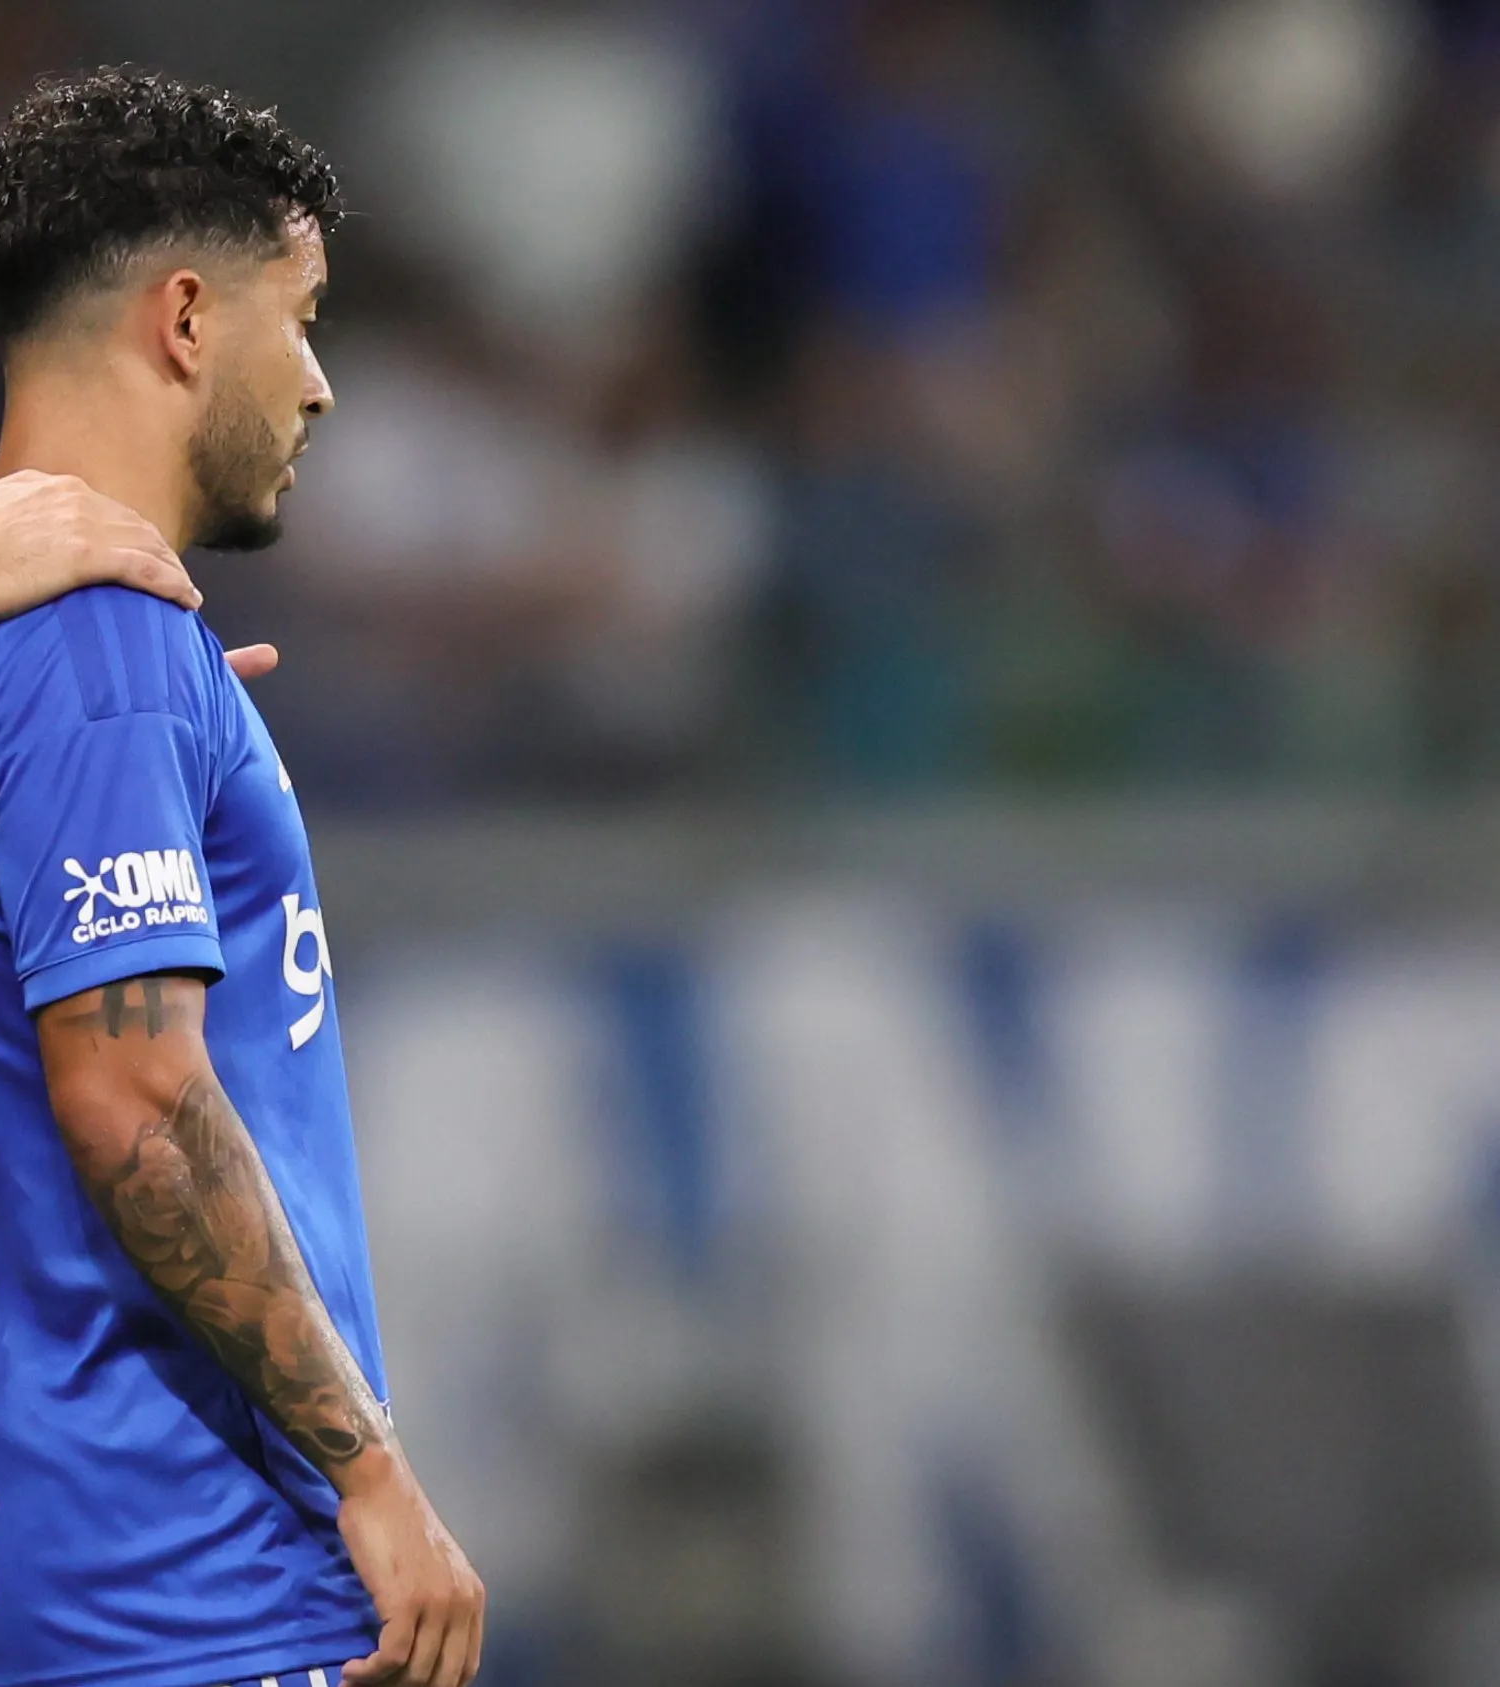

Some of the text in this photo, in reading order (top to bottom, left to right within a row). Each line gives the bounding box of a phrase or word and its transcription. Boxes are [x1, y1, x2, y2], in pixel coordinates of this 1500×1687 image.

[114, 849, 201, 908] OMO
[72, 902, 209, 944] CICLO RÁPIDO
